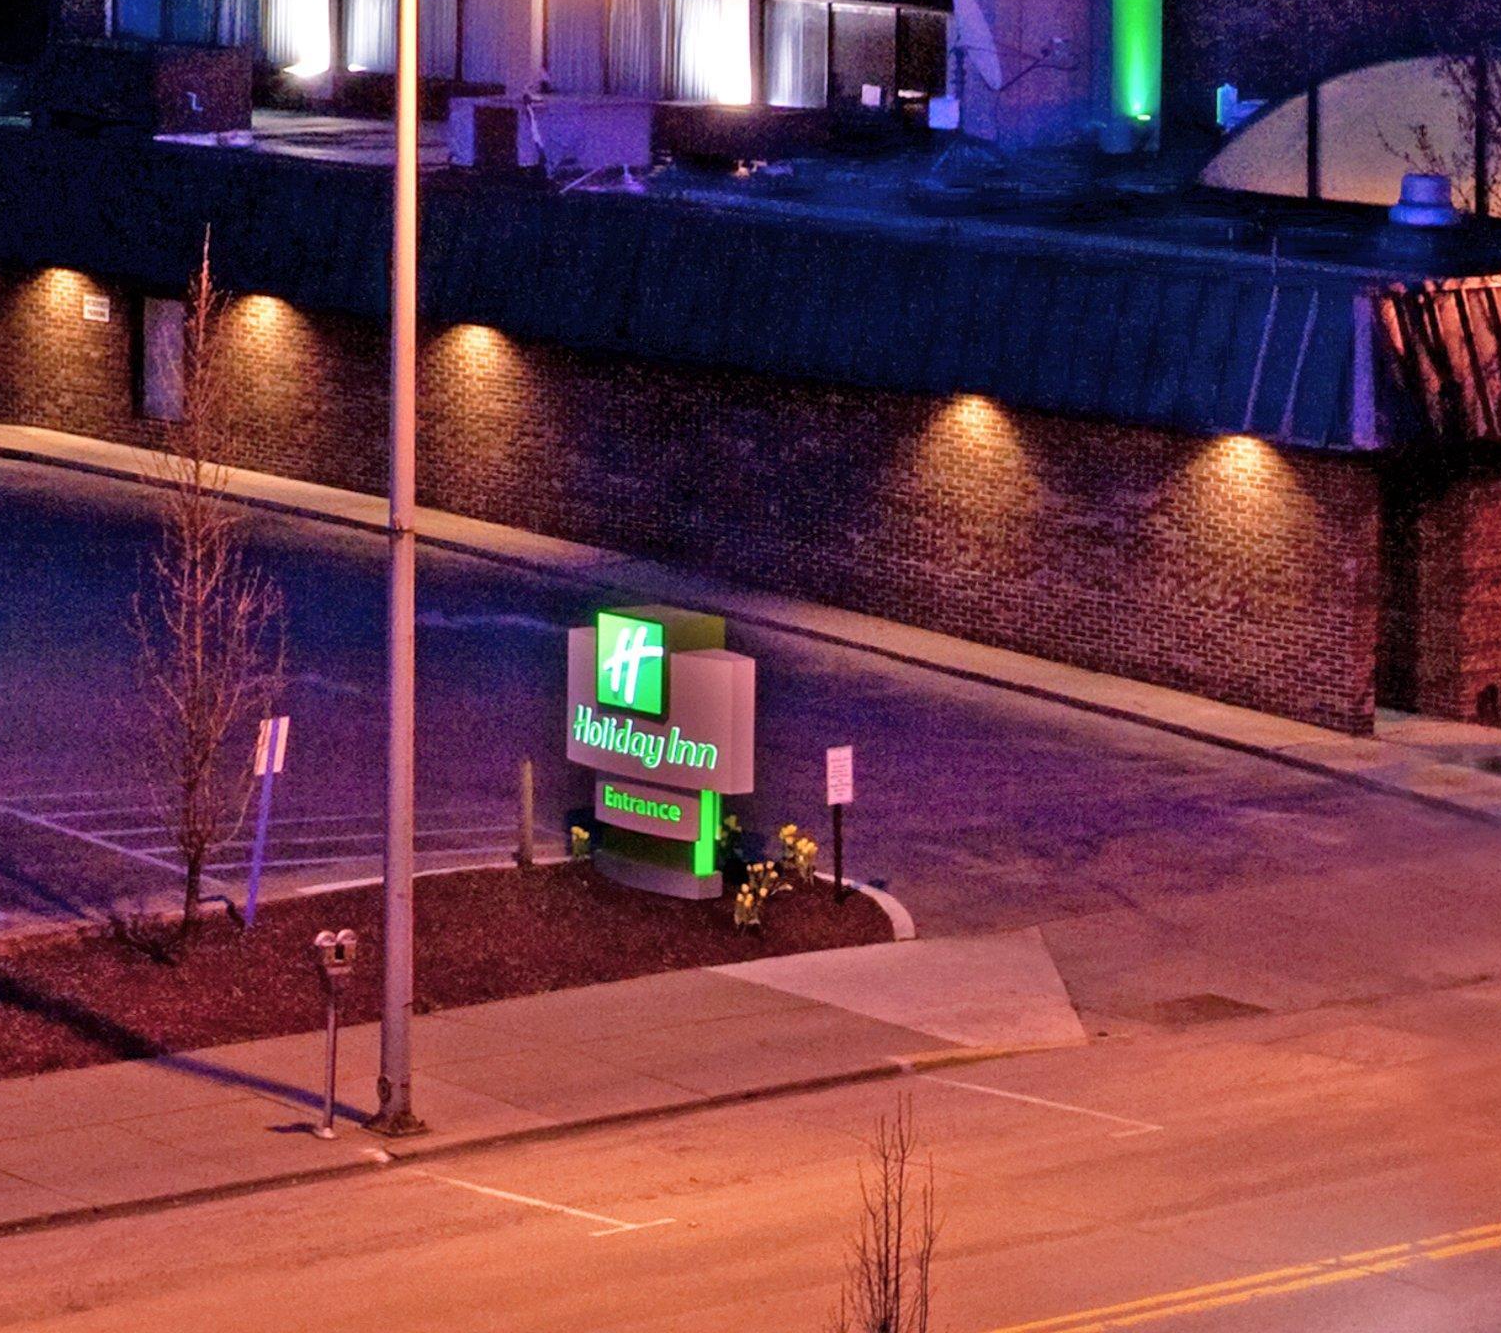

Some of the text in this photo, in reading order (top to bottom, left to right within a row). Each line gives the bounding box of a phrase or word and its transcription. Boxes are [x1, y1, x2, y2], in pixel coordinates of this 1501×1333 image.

[573, 704, 718, 770] Holiday Inn
[603, 784, 682, 822] Entrance
